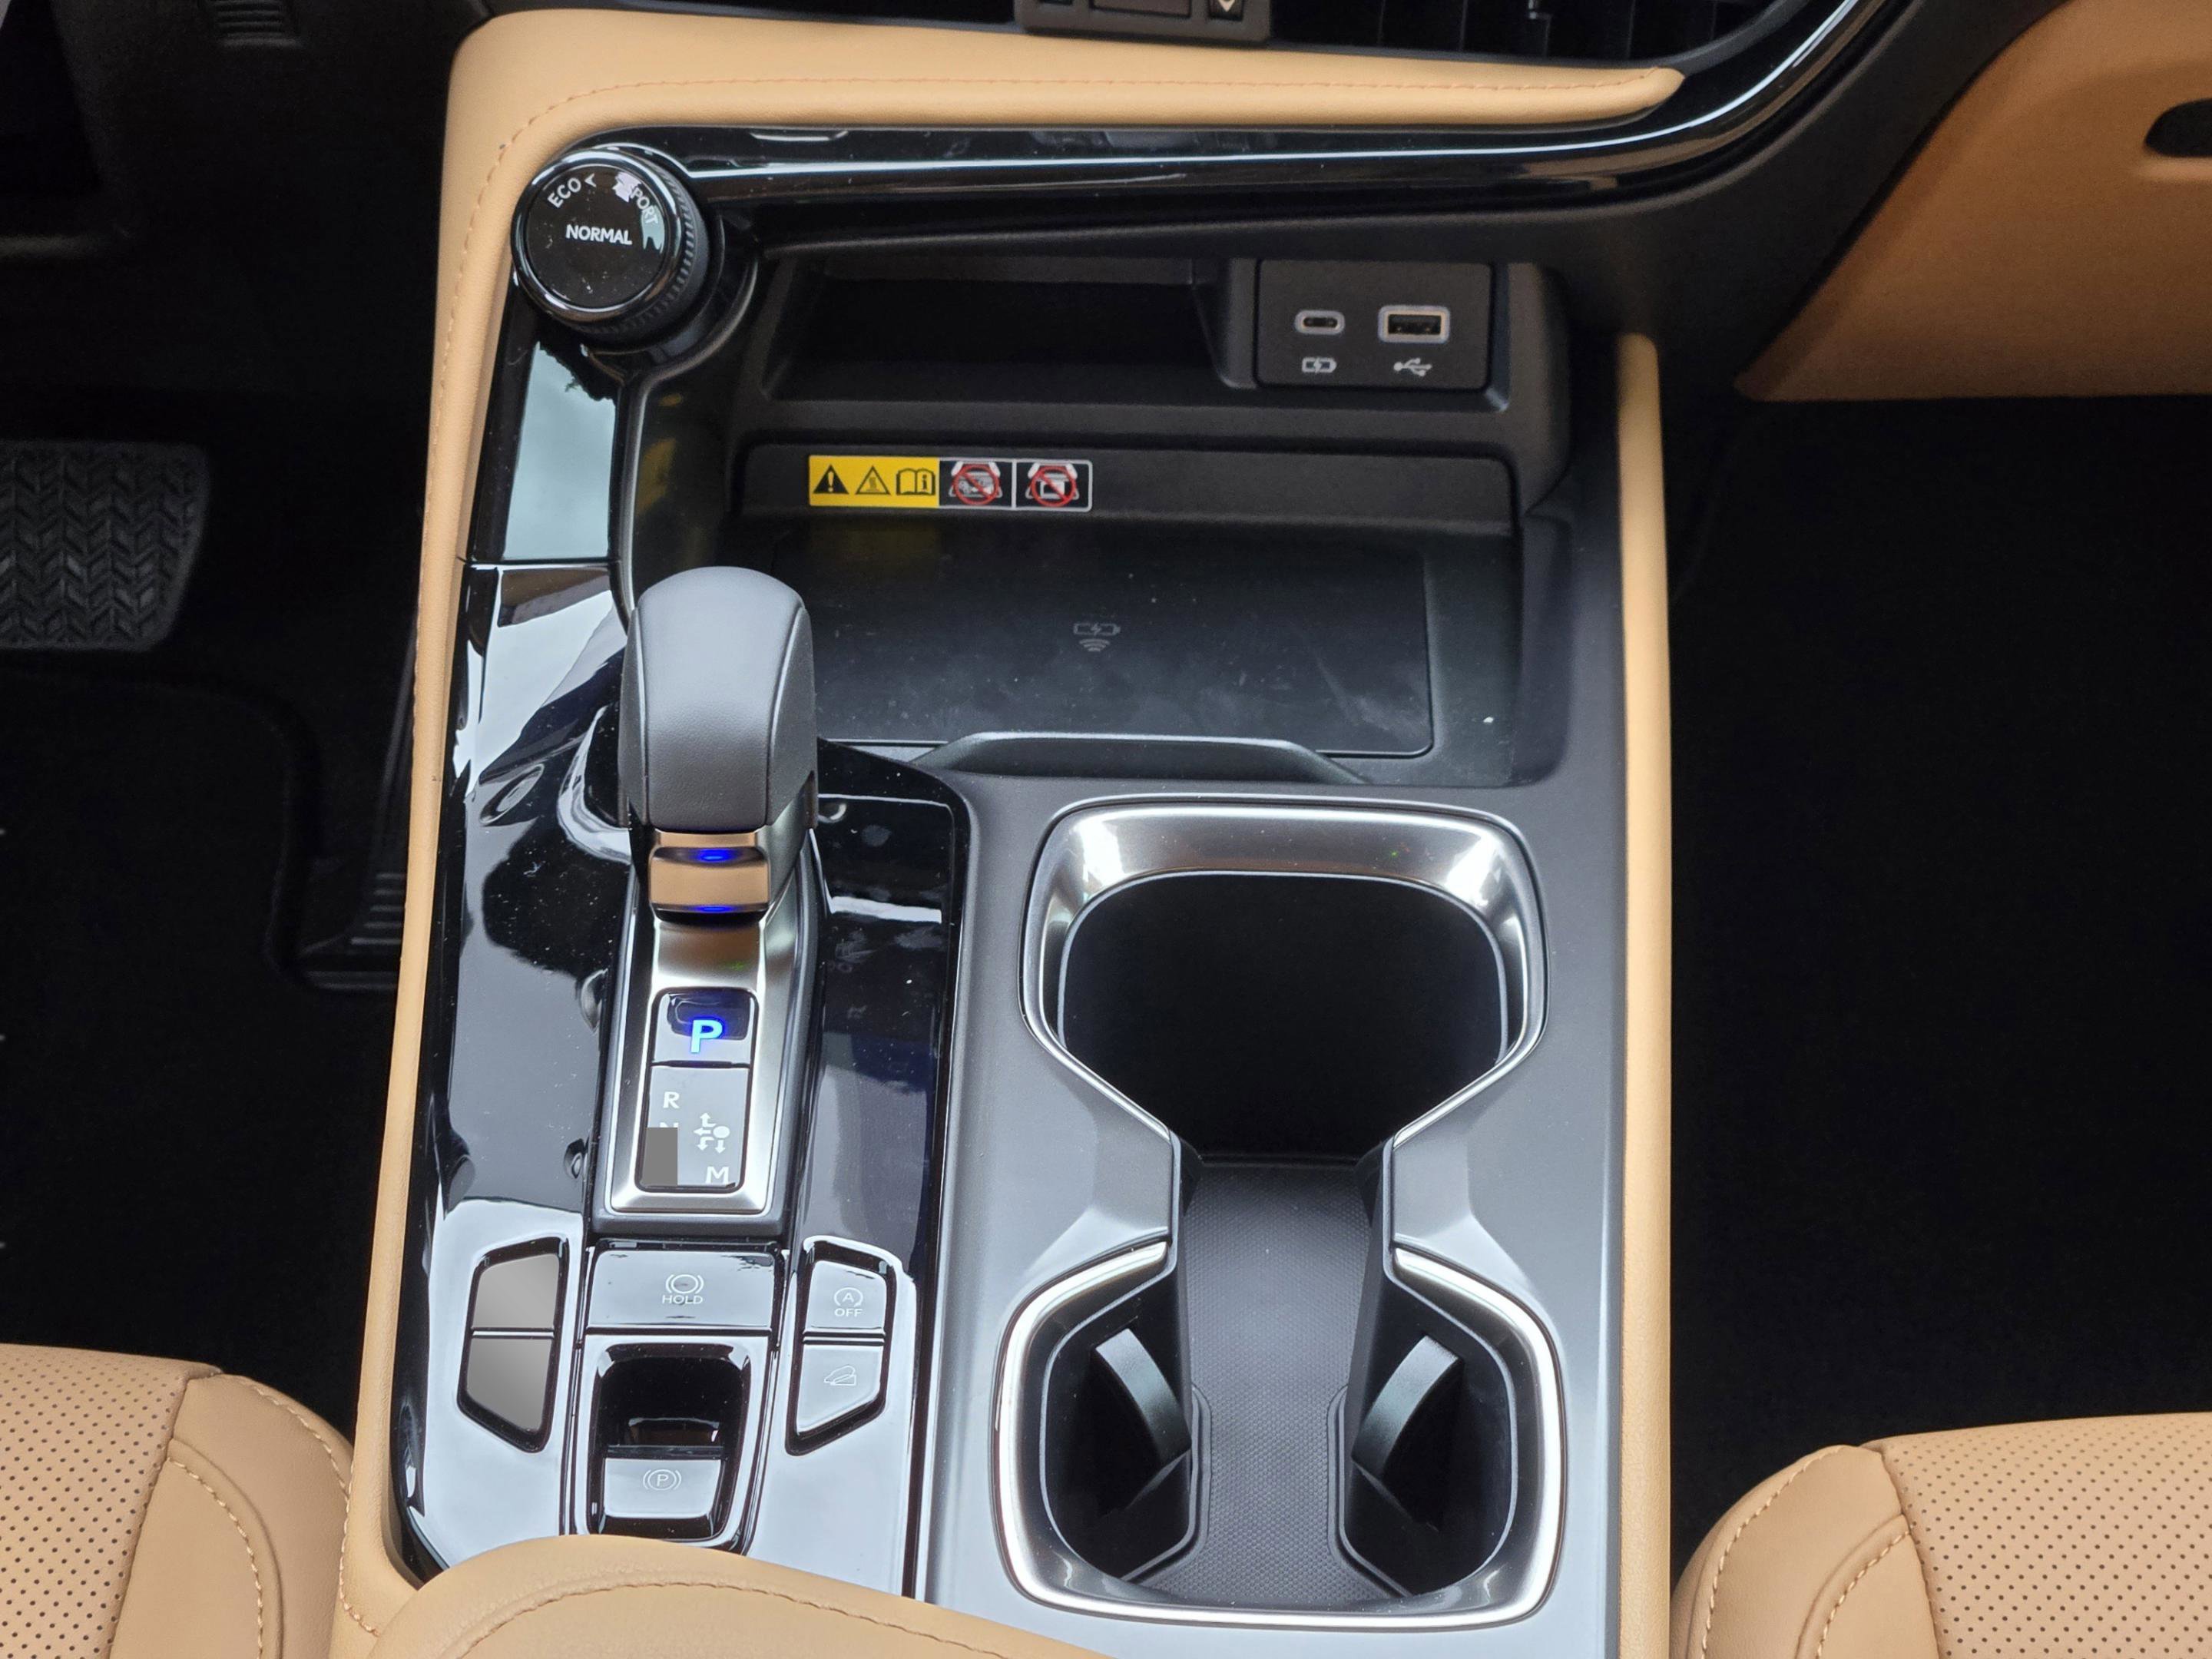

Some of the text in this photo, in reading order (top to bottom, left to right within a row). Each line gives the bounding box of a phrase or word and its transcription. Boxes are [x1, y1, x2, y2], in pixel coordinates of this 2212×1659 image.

[548, 177, 582, 208] ECO
[623, 180, 659, 225] PORT
[565, 224, 633, 245] NORMAL
[690, 1019, 724, 1054] P
[663, 1091, 680, 1108] R
[705, 1166, 730, 1184] M
[662, 1295, 704, 1304] HOLD
[834, 1308, 863, 1317] OFF
